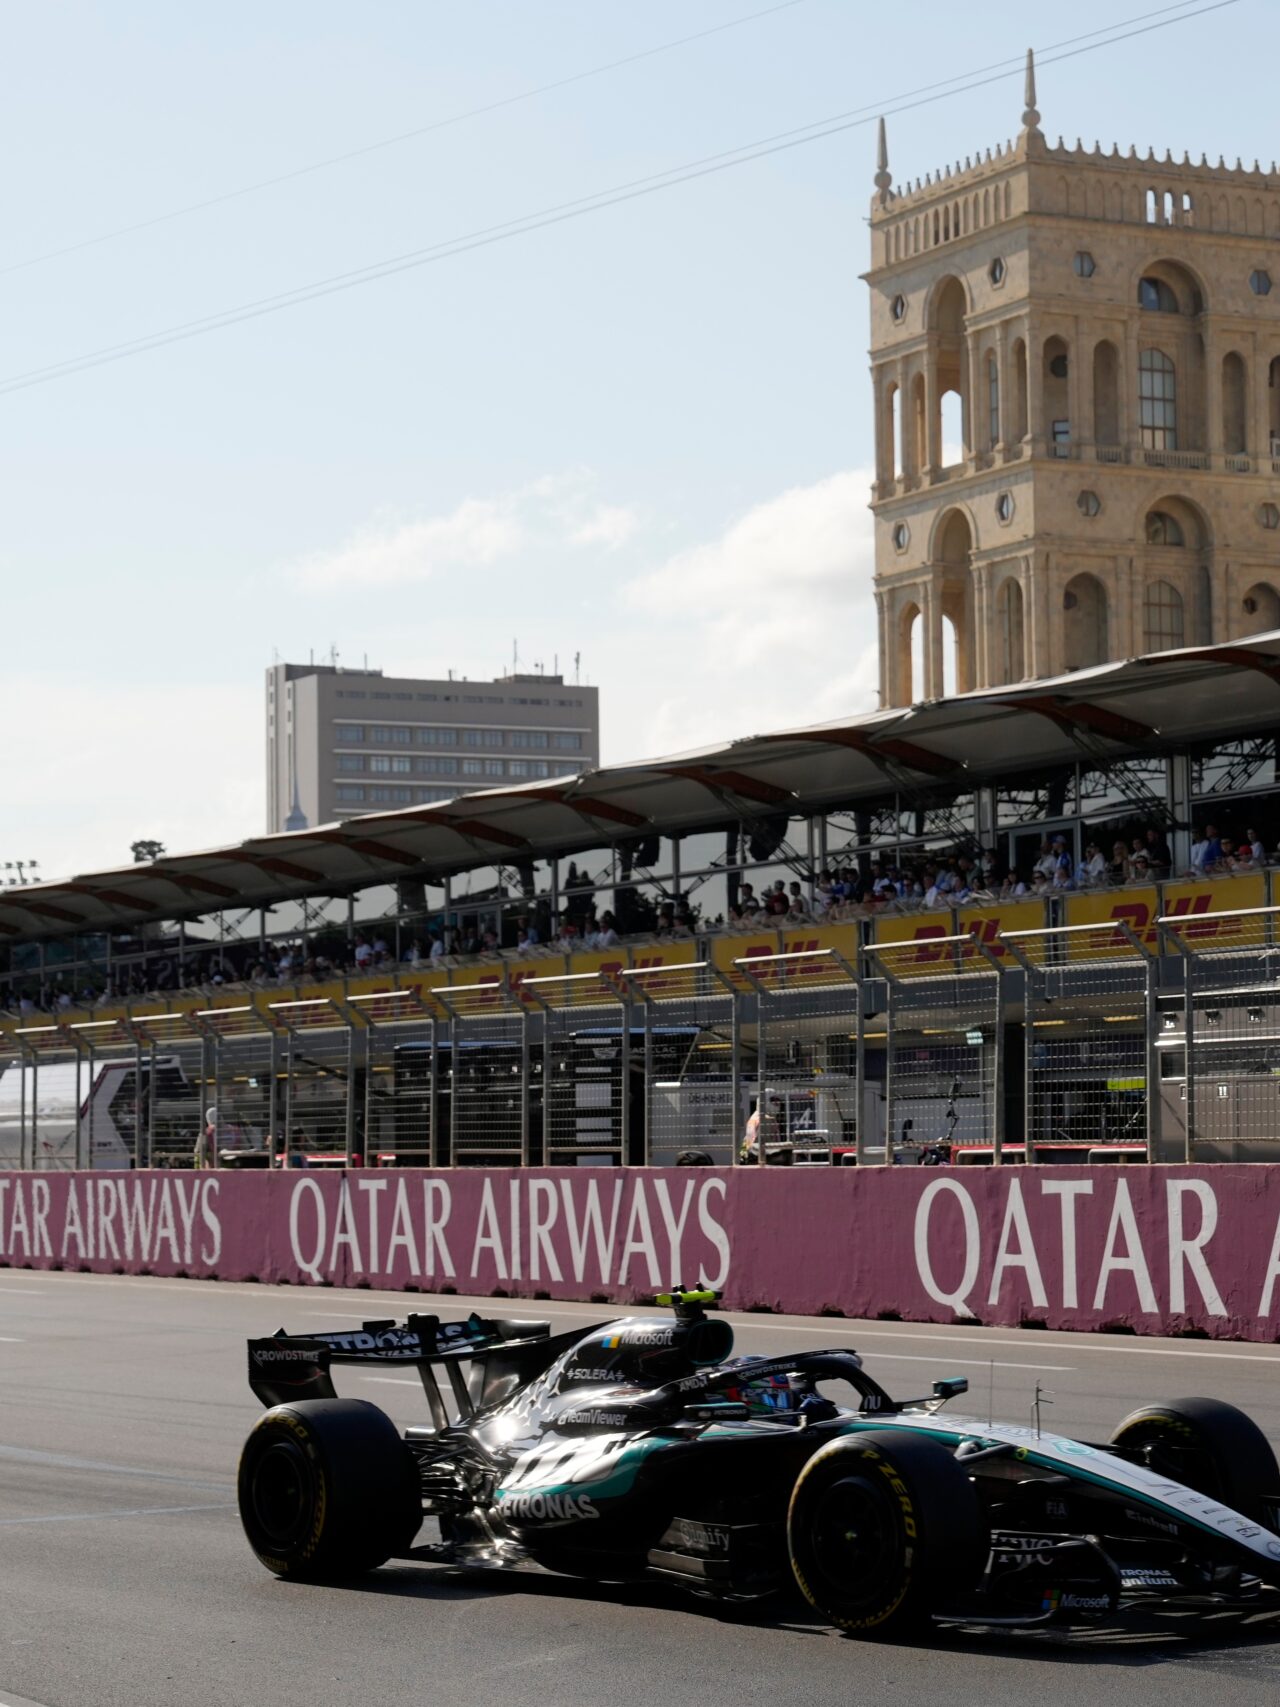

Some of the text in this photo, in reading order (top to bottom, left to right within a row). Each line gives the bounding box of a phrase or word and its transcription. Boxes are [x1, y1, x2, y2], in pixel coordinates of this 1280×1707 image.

[1104, 894, 1222, 942] DHL
[914, 919, 1010, 963] DHL
[62, 1177, 222, 1266] AIRWAYS
[289, 1177, 730, 1291] QATAR AIRWAYS
[914, 1176, 1228, 1317] QATAR
[621, 1329, 674, 1345] Microsoft
[255, 1349, 319, 1363] CROWDSTRIKE
[573, 1368, 616, 1381] SOLERA
[679, 1378, 703, 1392] AMD
[566, 1410, 628, 1426] TeamViewer
[1120, 1576, 1178, 1587] yntium
[1060, 1593, 1110, 1609] Microsoft
